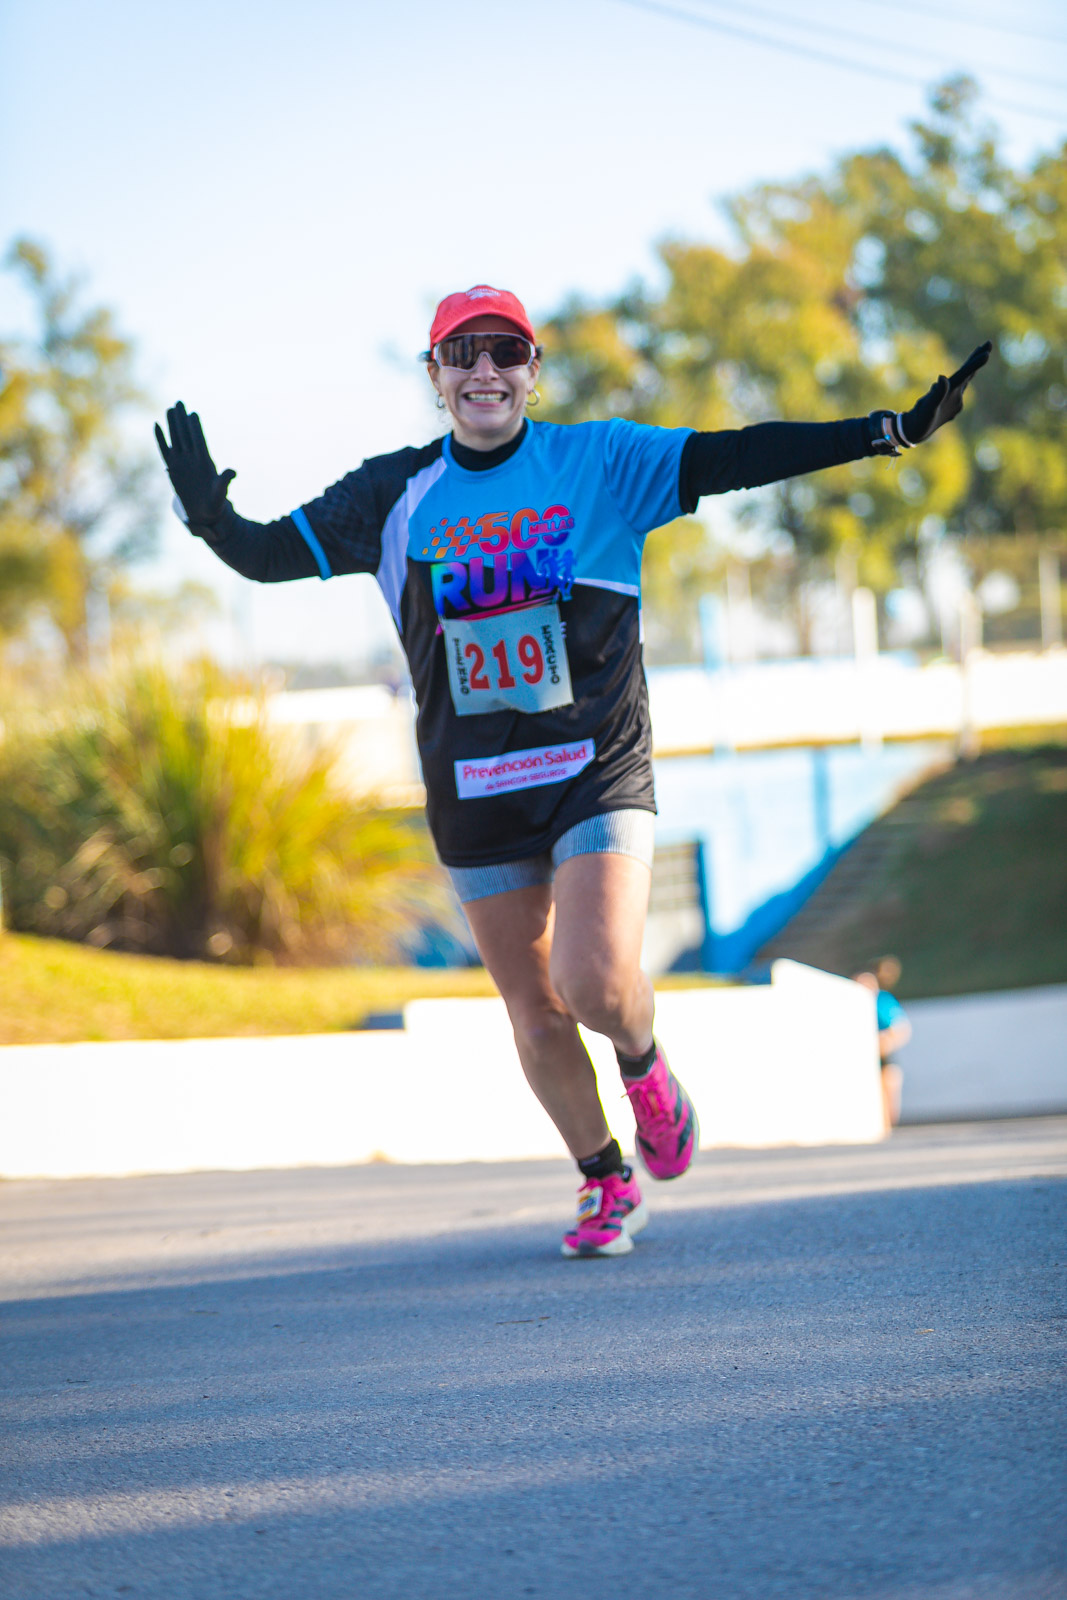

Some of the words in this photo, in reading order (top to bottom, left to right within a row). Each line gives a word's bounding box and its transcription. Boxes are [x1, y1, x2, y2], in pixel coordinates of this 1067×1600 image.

[528, 517, 575, 535] MILLAS
[464, 634, 544, 690] 219
[463, 757, 543, 779] Prevención
[544, 745, 586, 764] Salud
